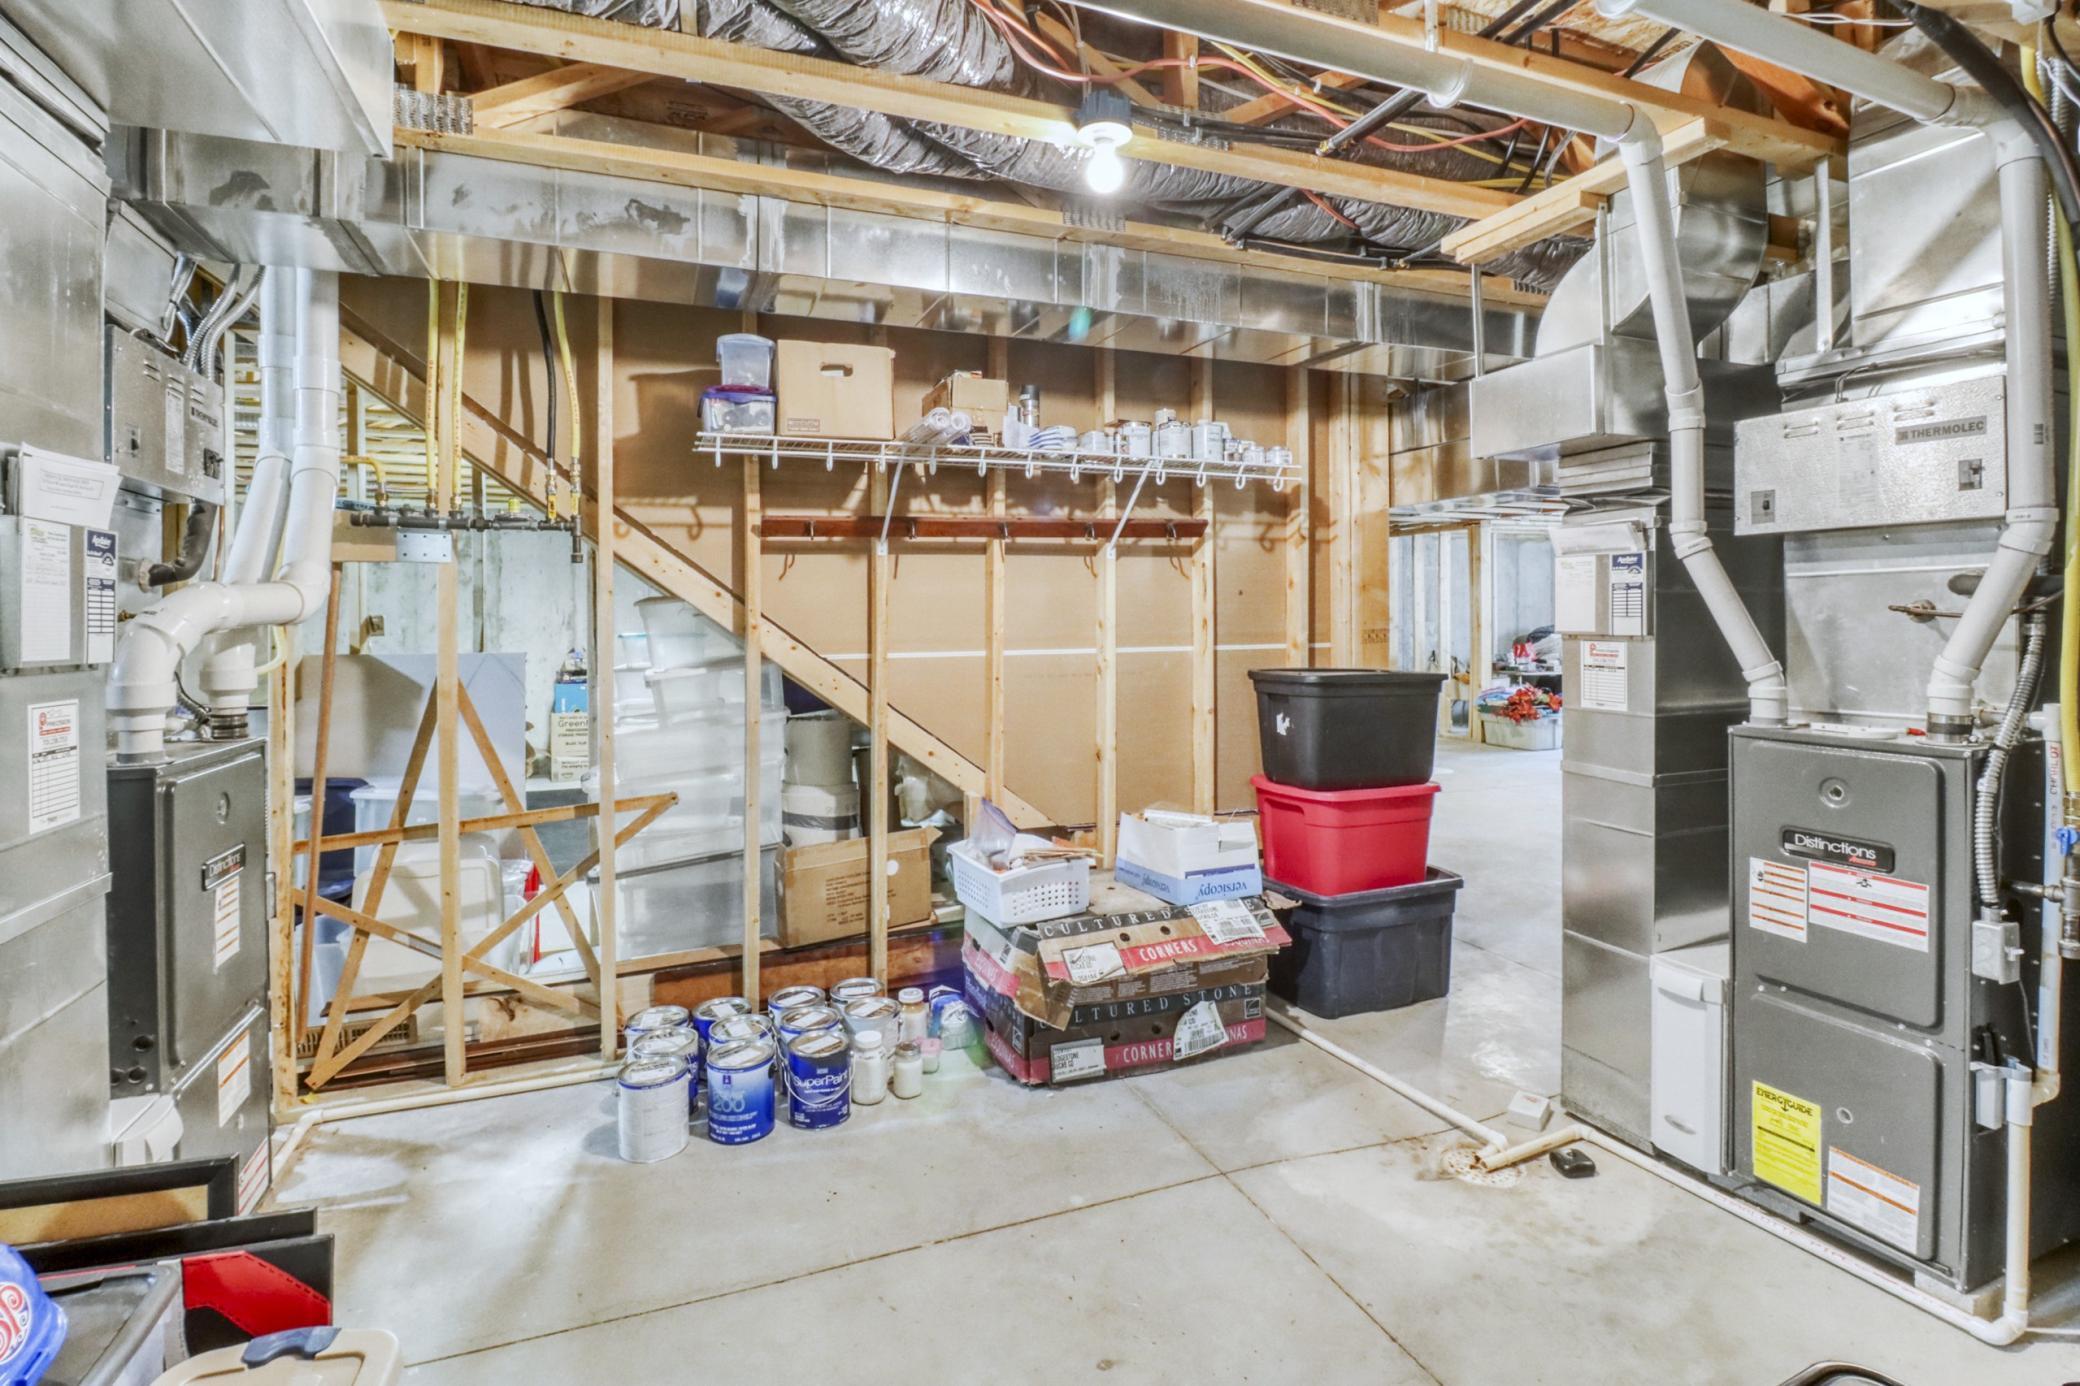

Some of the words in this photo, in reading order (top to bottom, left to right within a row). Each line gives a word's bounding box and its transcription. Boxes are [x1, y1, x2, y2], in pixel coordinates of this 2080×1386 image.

[1911, 420, 1985, 439] THERMOLEC
[1794, 833, 1877, 860] Distinctions
[1198, 881, 1248, 897] versicopy
[1044, 909, 1172, 937] CULTURED
[1140, 939, 1198, 962] CORNERS
[1182, 984, 1252, 1007] STONE
[1123, 1041, 1173, 1064] CORNER
[713, 1096, 746, 1113] 200
